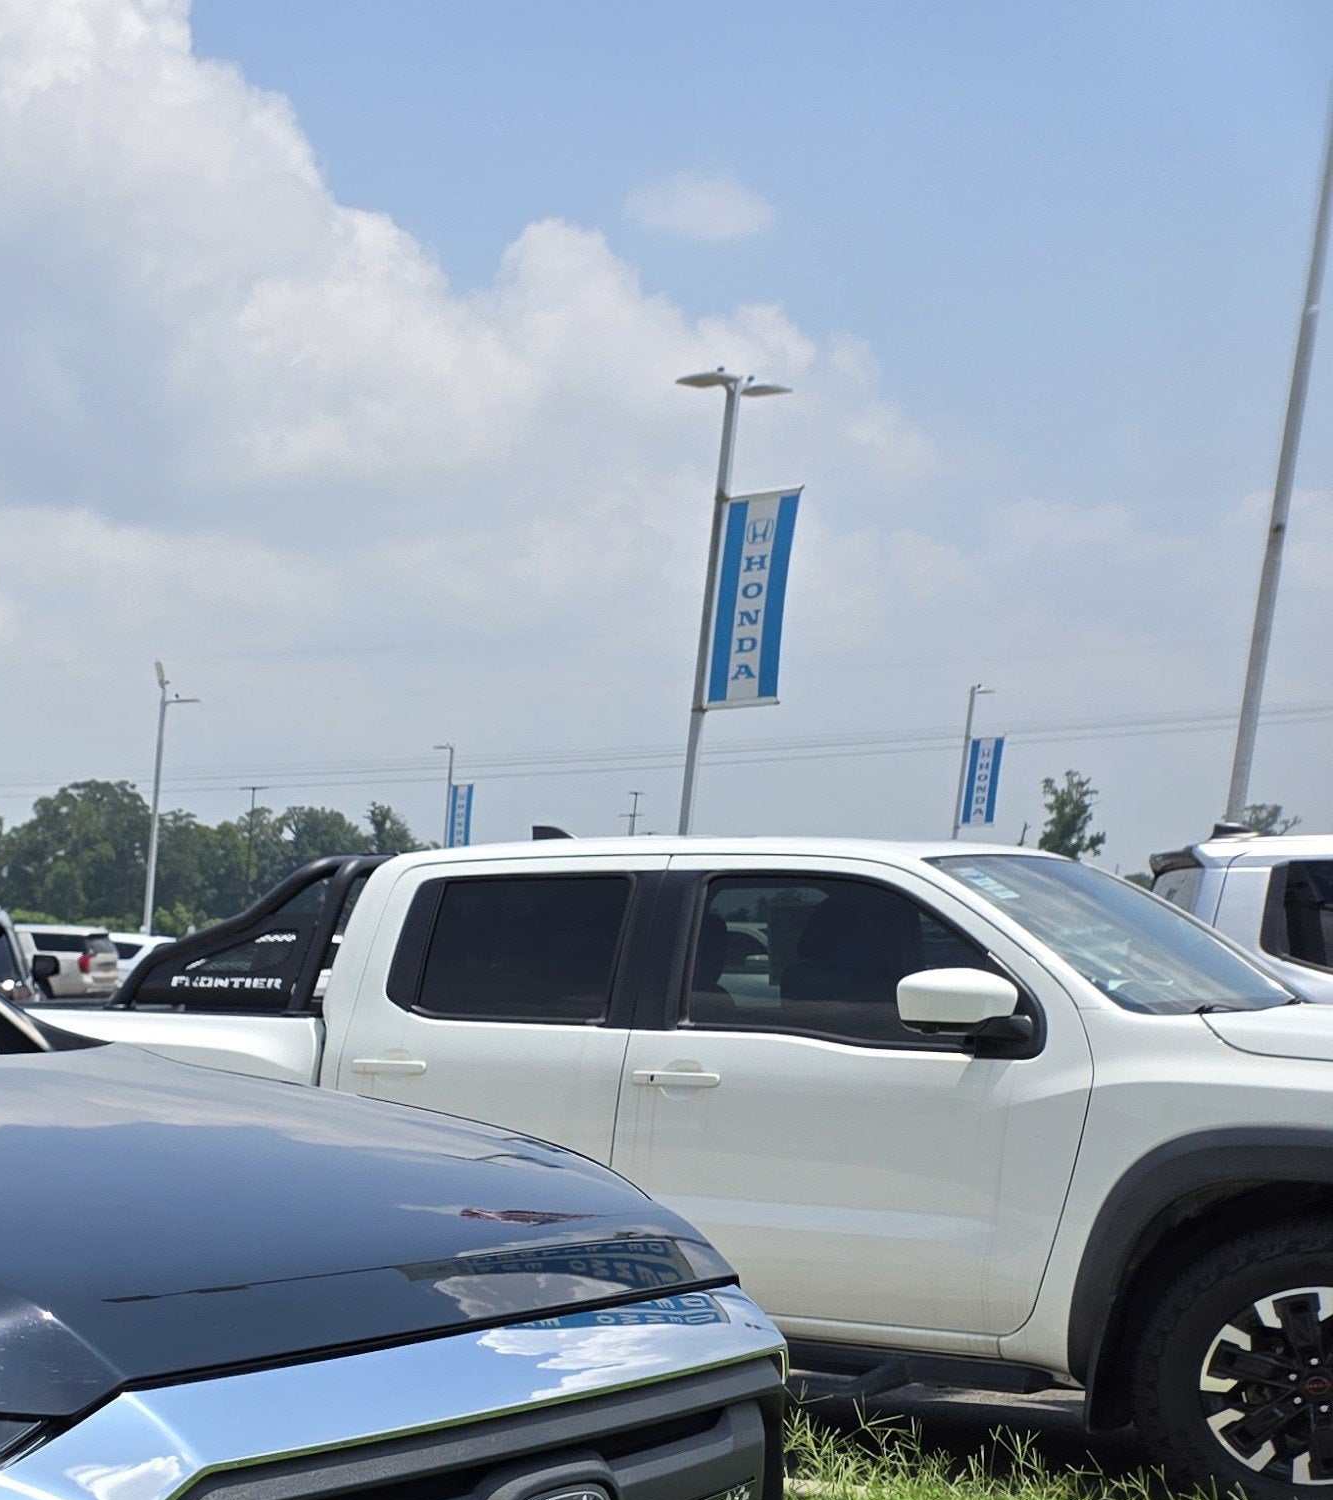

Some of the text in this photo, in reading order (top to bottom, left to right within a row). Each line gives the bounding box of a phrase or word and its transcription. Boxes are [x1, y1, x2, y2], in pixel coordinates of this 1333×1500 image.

[731, 554, 767, 681] HONDA
[973, 761, 990, 816] HONDA
[170, 975, 282, 989] FRONTIER
